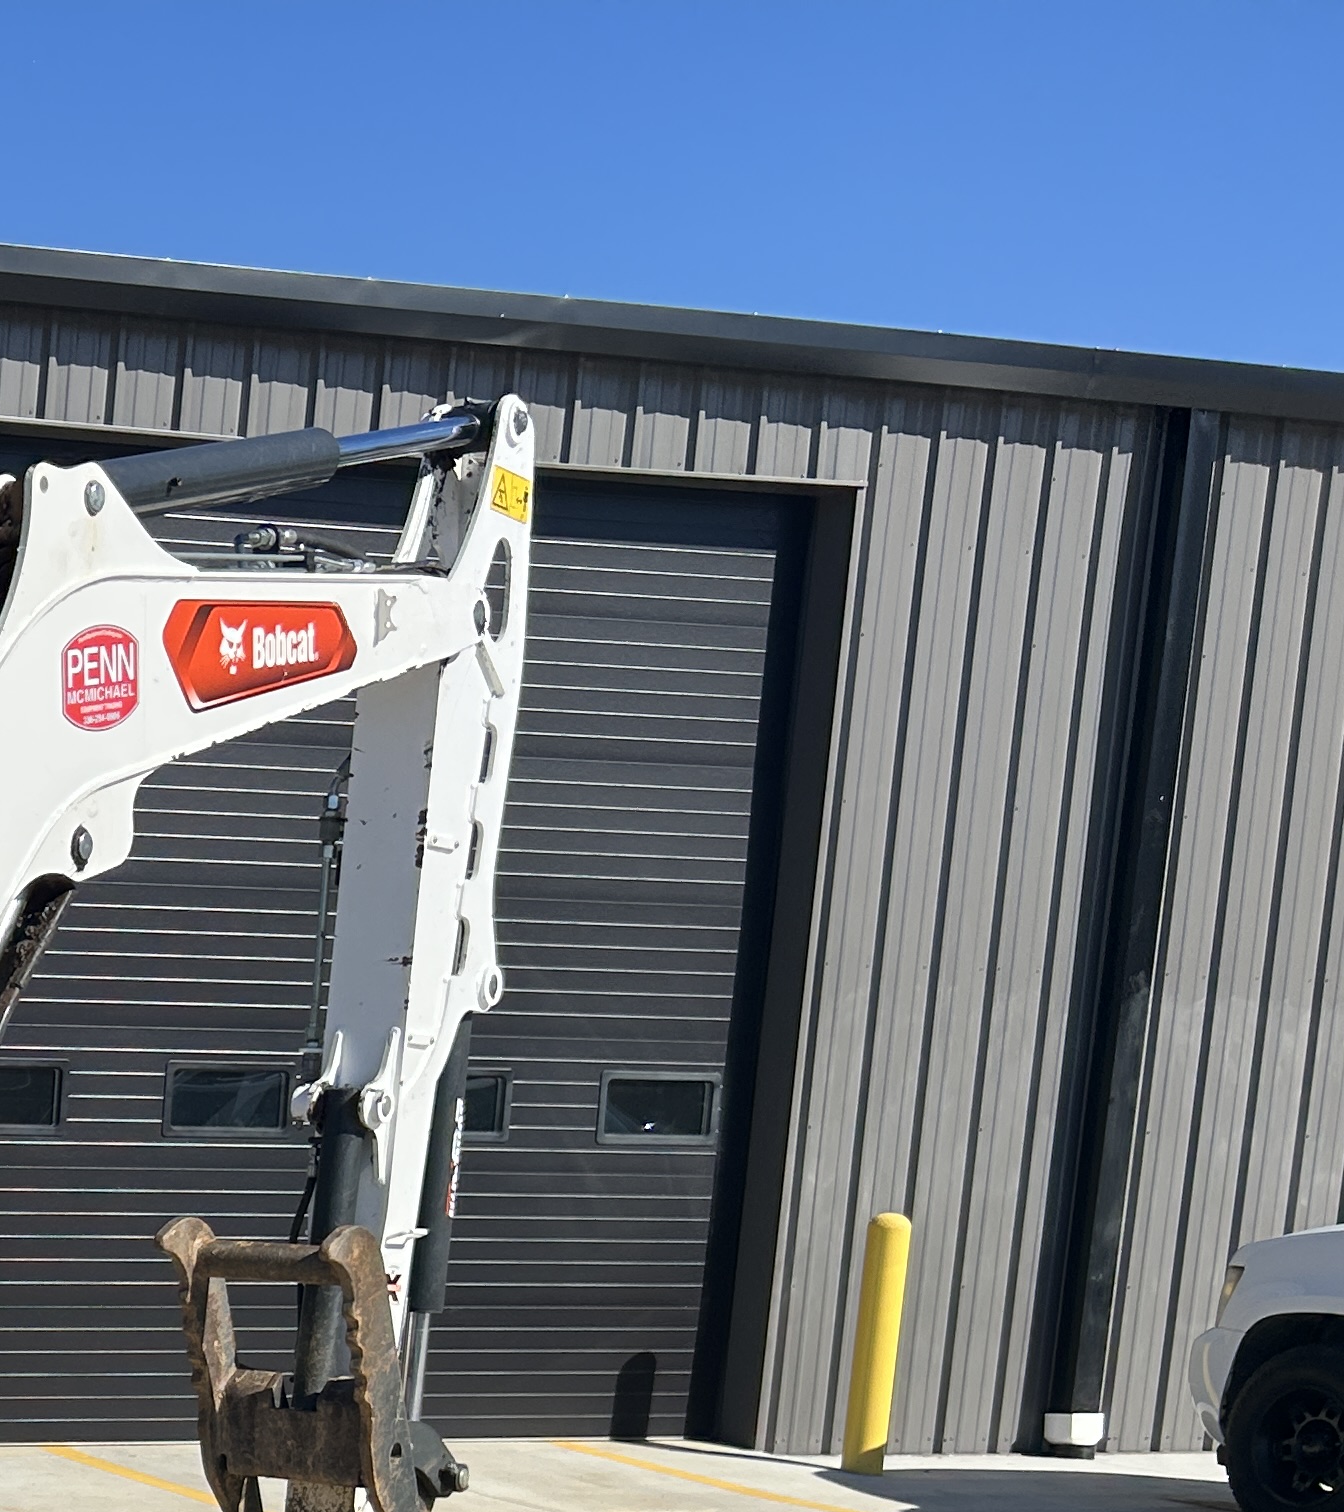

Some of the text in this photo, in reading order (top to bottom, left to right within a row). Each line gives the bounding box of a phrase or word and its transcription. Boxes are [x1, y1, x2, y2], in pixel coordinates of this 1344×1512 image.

[67, 642, 135, 689] PENN
[252, 621, 316, 669] Bobcat
[67, 683, 136, 705] MCMICHAEL
